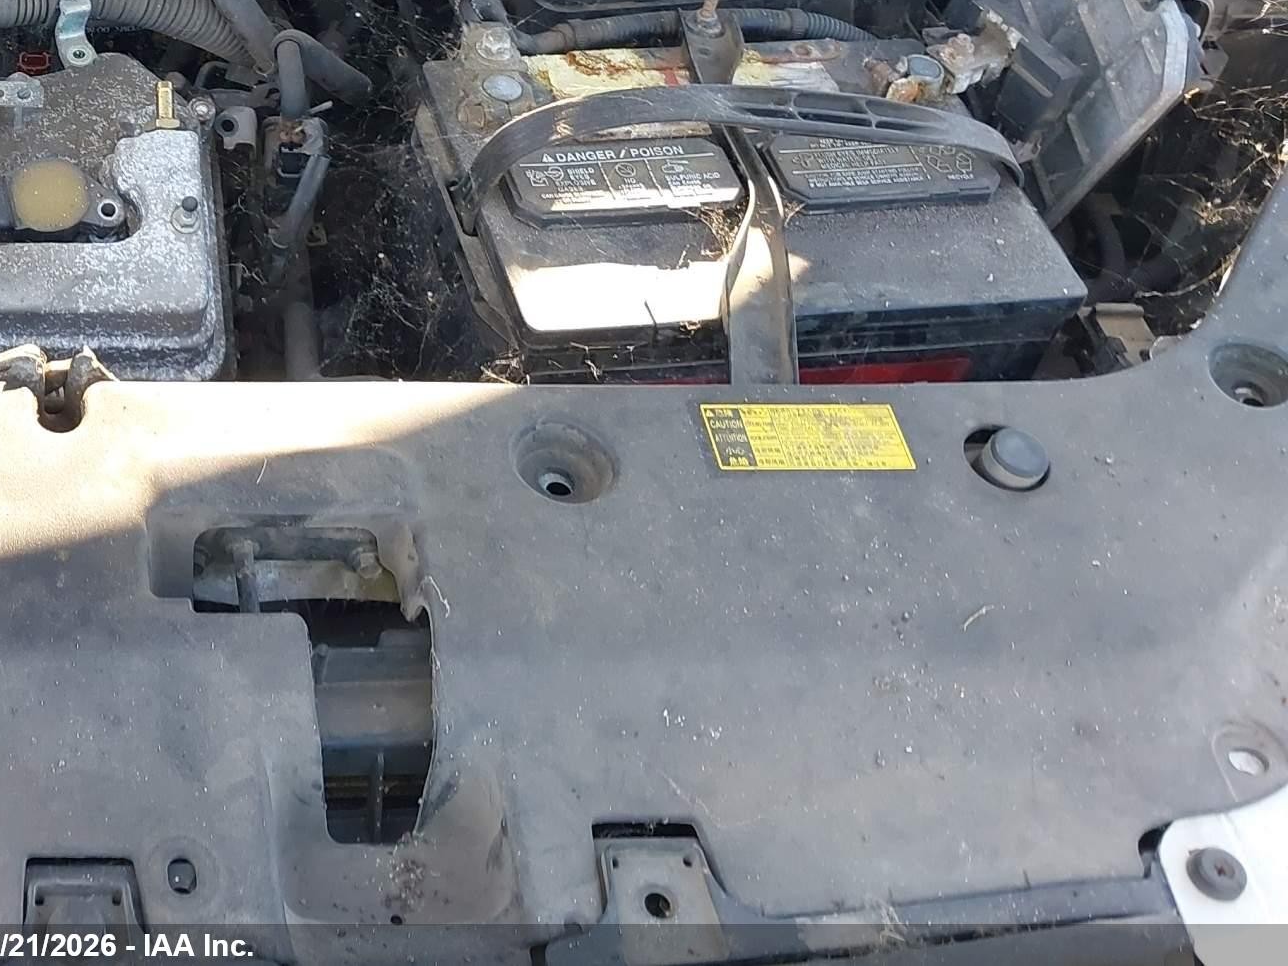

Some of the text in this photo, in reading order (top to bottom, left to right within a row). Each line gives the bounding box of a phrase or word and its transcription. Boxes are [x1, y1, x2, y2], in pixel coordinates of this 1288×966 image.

[556, 149, 616, 163] DANGER
[629, 145, 684, 158] POISON
[703, 171, 721, 179] ACID
[710, 418, 744, 429] CAUTION
[715, 432, 748, 443] ATTENTION
